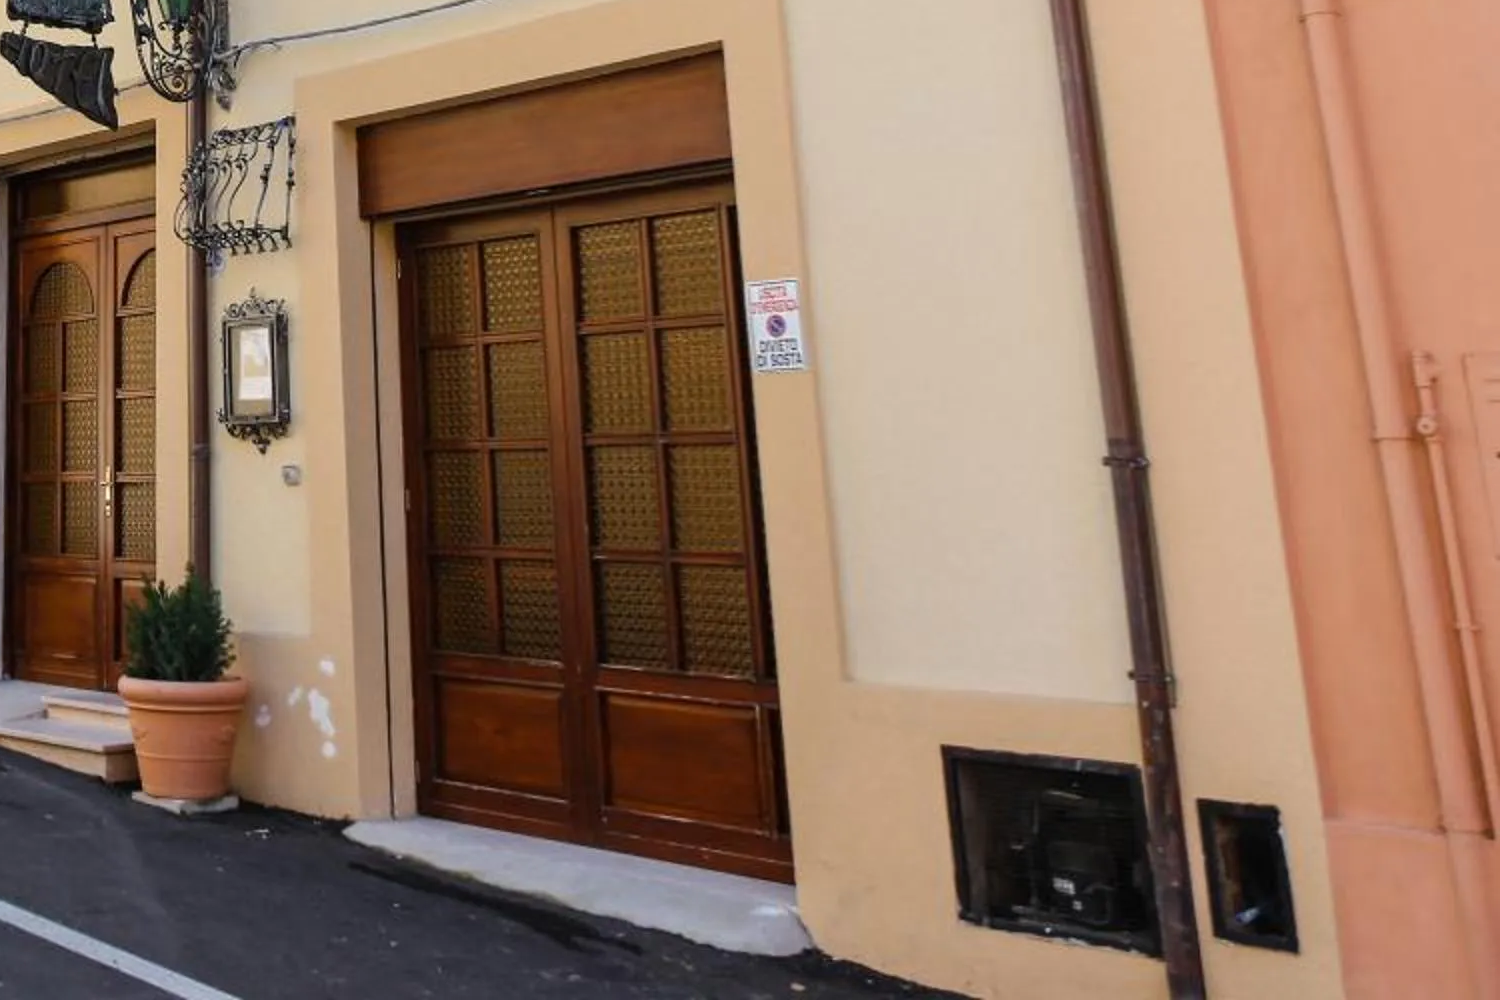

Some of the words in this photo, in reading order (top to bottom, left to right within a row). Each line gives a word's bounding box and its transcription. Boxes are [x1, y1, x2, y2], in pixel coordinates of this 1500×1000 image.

[759, 337, 798, 353] DIVIETO
[755, 354, 768, 367] DI
[770, 352, 803, 367] SOSTA
